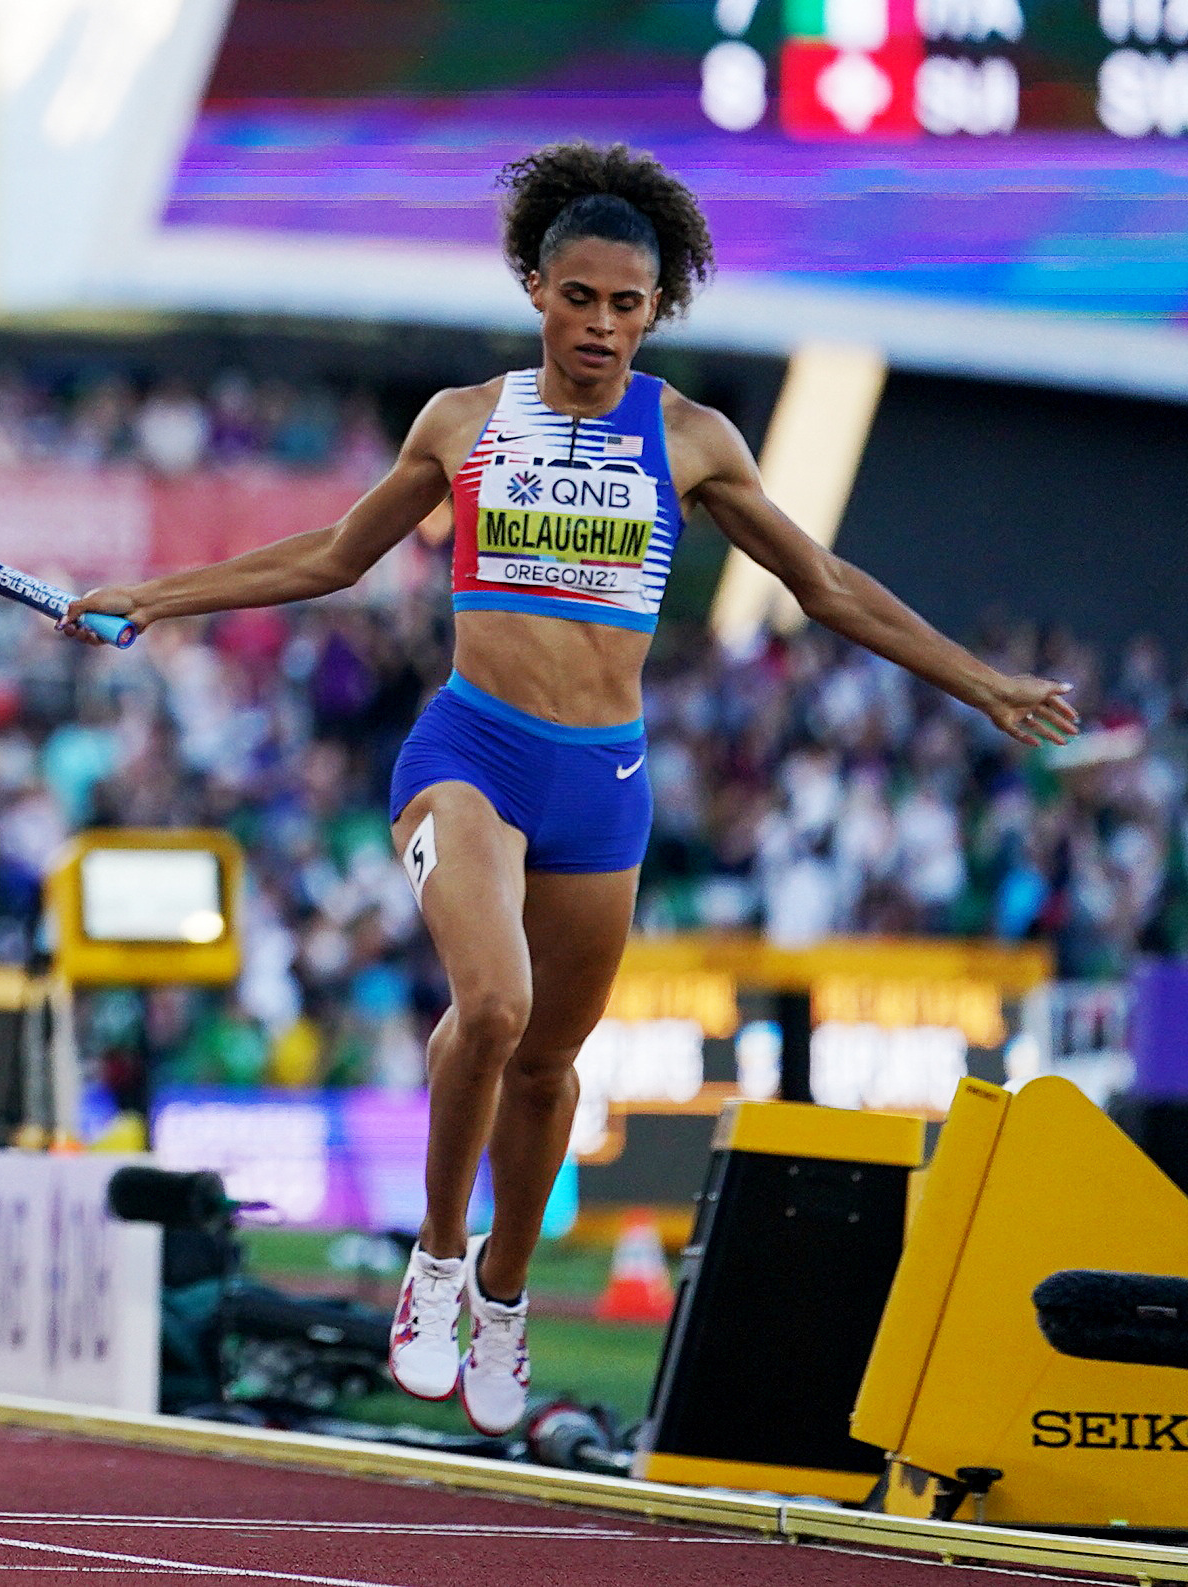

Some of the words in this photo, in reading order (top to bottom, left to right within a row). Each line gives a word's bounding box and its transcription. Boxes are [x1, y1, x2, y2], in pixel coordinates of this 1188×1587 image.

[552, 478, 631, 508] QNB
[486, 511, 646, 557] McLAUGHLIN
[504, 563, 618, 588] OREGON22
[1031, 1410, 1188, 1451] SEIK
